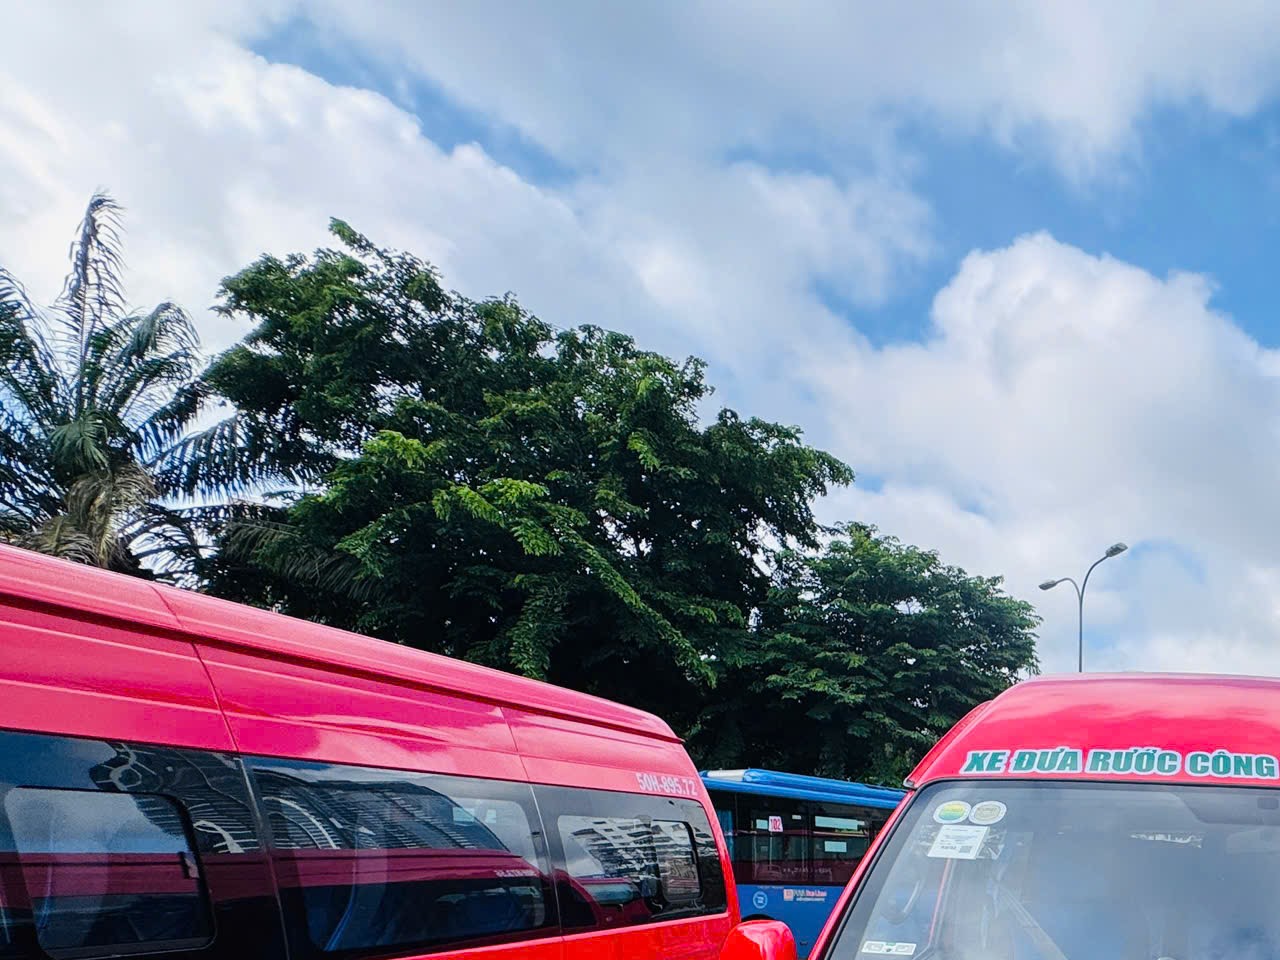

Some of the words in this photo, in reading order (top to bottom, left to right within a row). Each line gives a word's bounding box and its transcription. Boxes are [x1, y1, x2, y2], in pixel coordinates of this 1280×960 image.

[962, 750, 1007, 773] XE
[1009, 748, 1079, 773] ĐƯA
[1088, 747, 1179, 774] RƯỚC
[1187, 750, 1276, 777] CÔNG
[769, 818, 781, 831] 102
